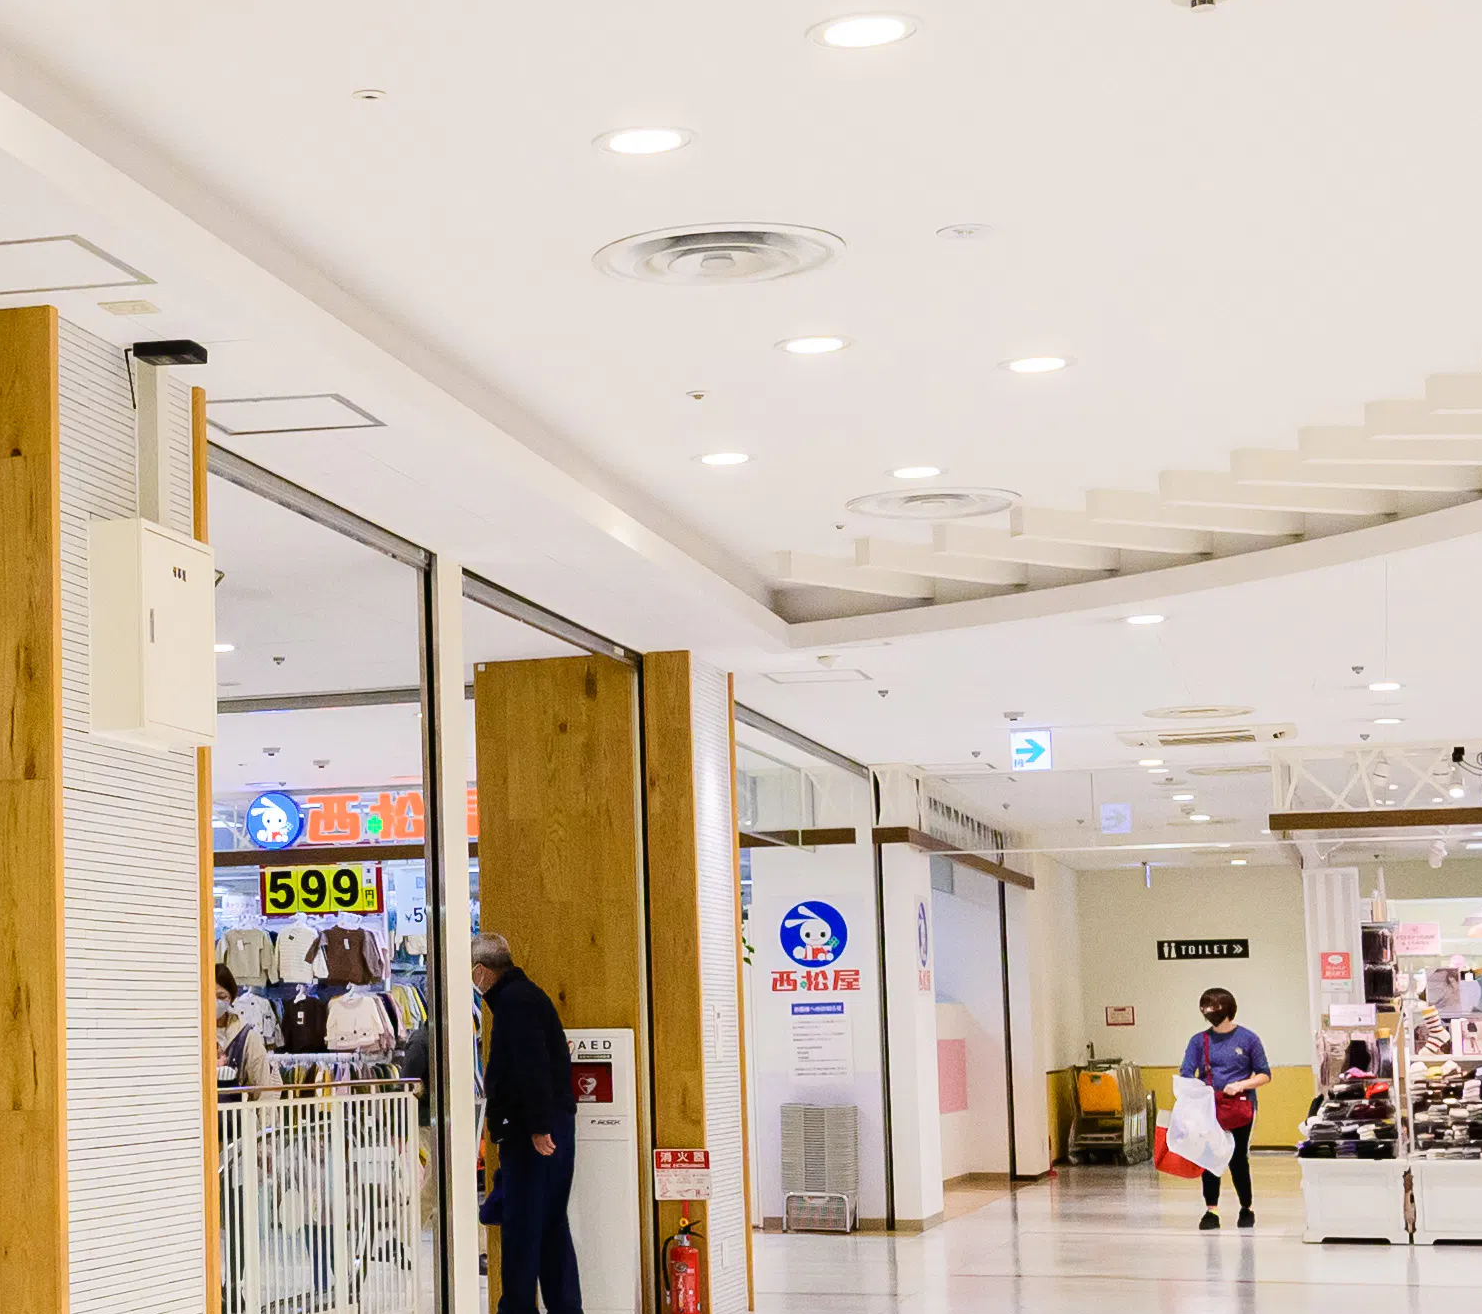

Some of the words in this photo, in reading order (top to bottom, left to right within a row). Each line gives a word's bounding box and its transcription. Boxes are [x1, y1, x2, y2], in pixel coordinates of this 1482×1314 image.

[269, 868, 359, 910] 599
[404, 907, 427, 924] ¥5
[1181, 944, 1228, 956] TOILET
[770, 969, 861, 992] 西松屋
[577, 1040, 613, 1050] AED
[660, 1151, 705, 1163] 消火器
